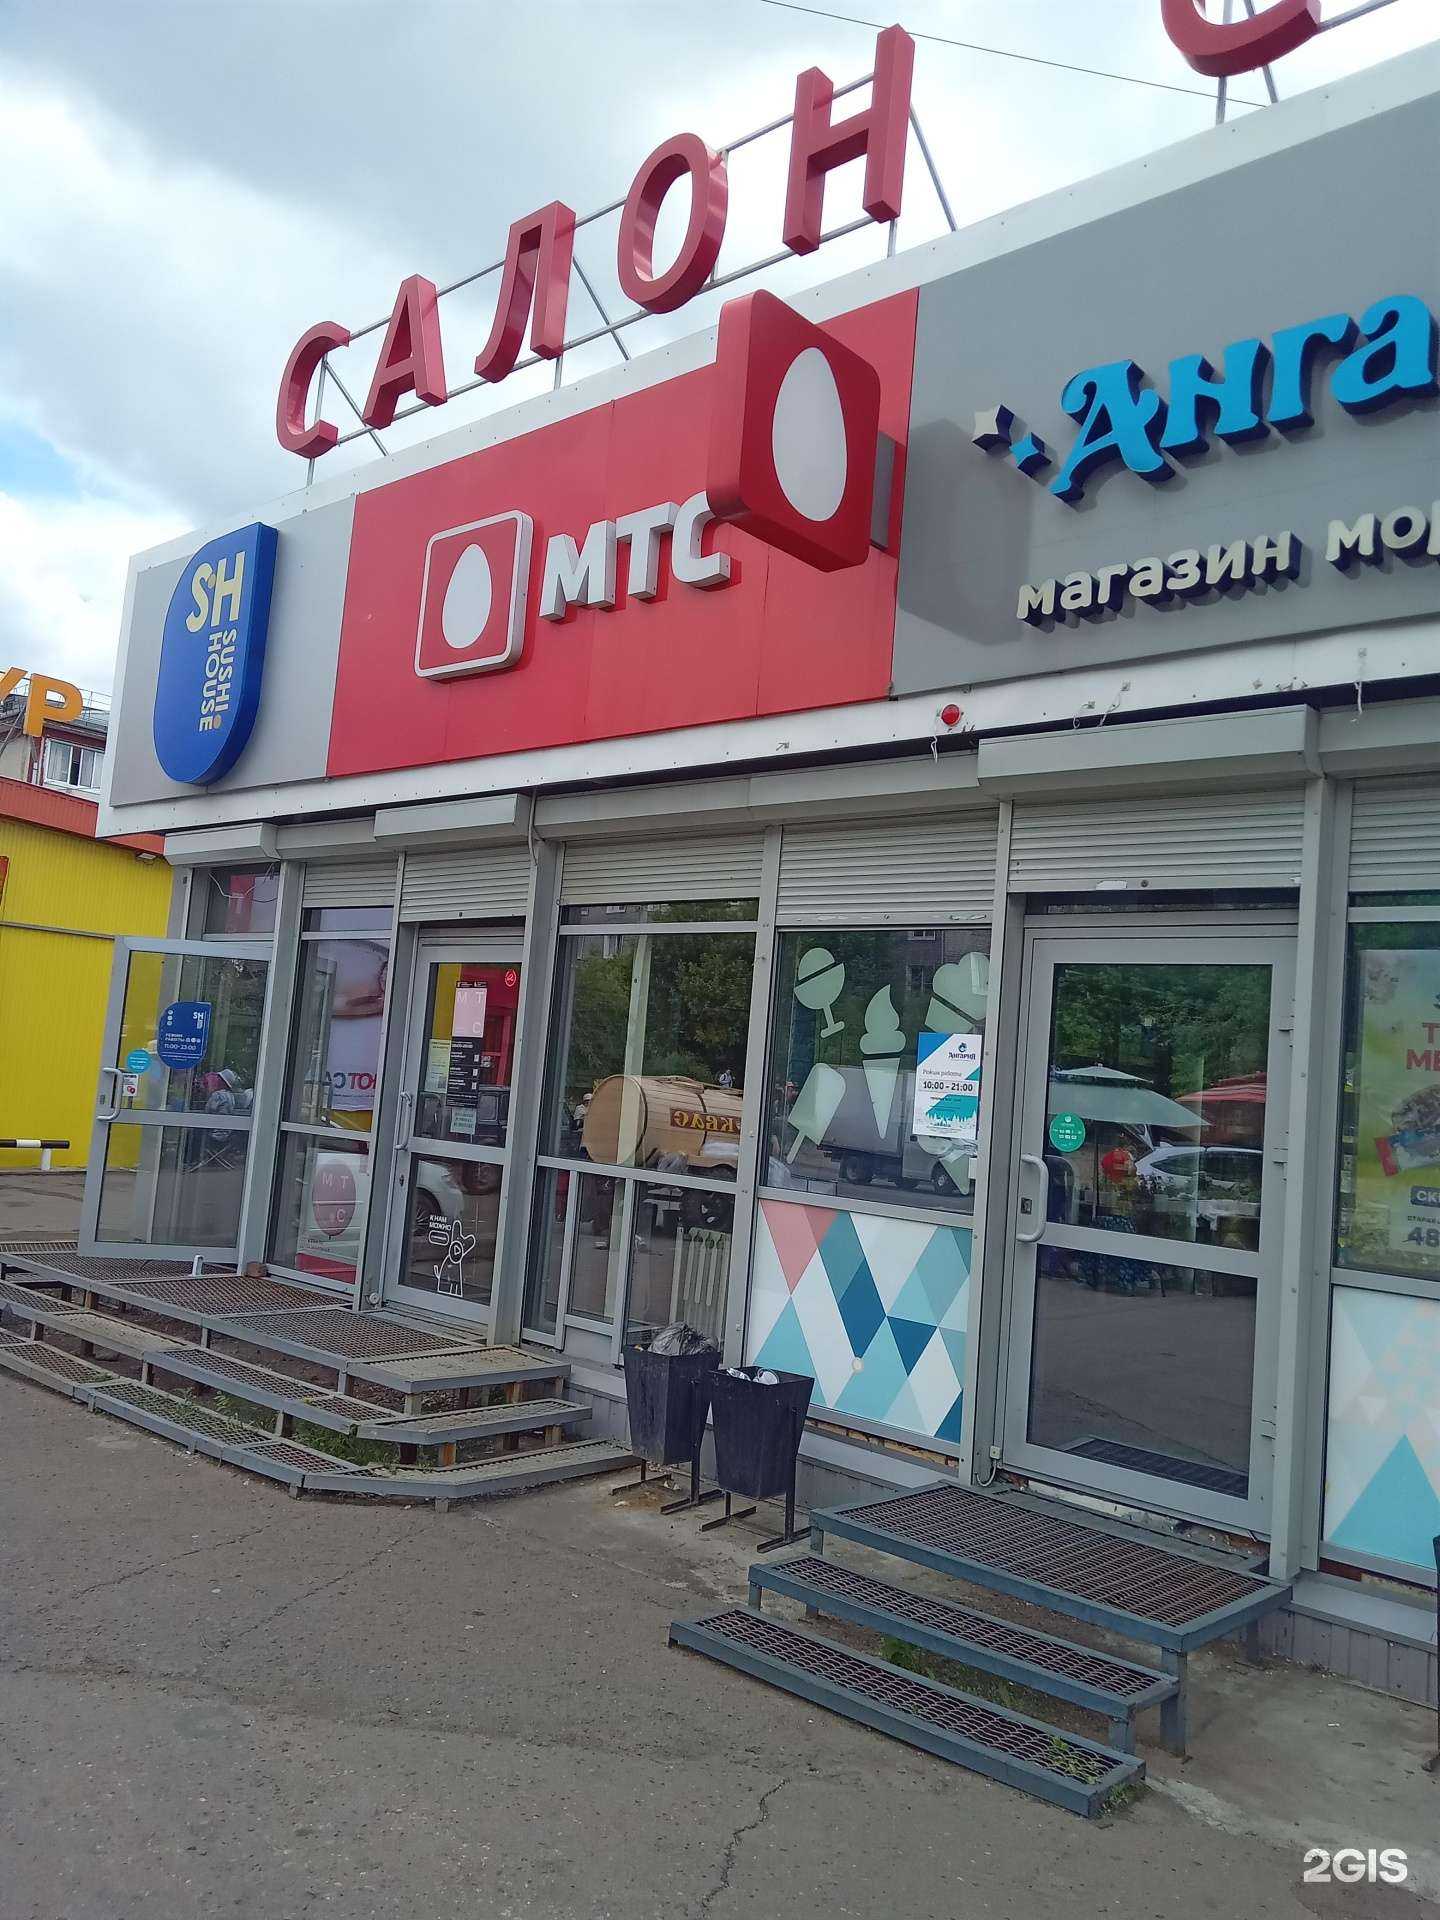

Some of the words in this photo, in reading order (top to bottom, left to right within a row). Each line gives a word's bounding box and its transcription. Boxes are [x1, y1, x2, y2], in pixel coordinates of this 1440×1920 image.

[276, 23, 915, 458] САЛОН
[185, 551, 246, 633] SH
[539, 490, 731, 622] МТС
[1016, 530, 1306, 627] магазин
[199, 631, 223, 732] HOUSE
[214, 629, 237, 713] SUSHI
[922, 1080, 944, 1091] 10:00
[951, 1082, 973, 1092] 21:00
